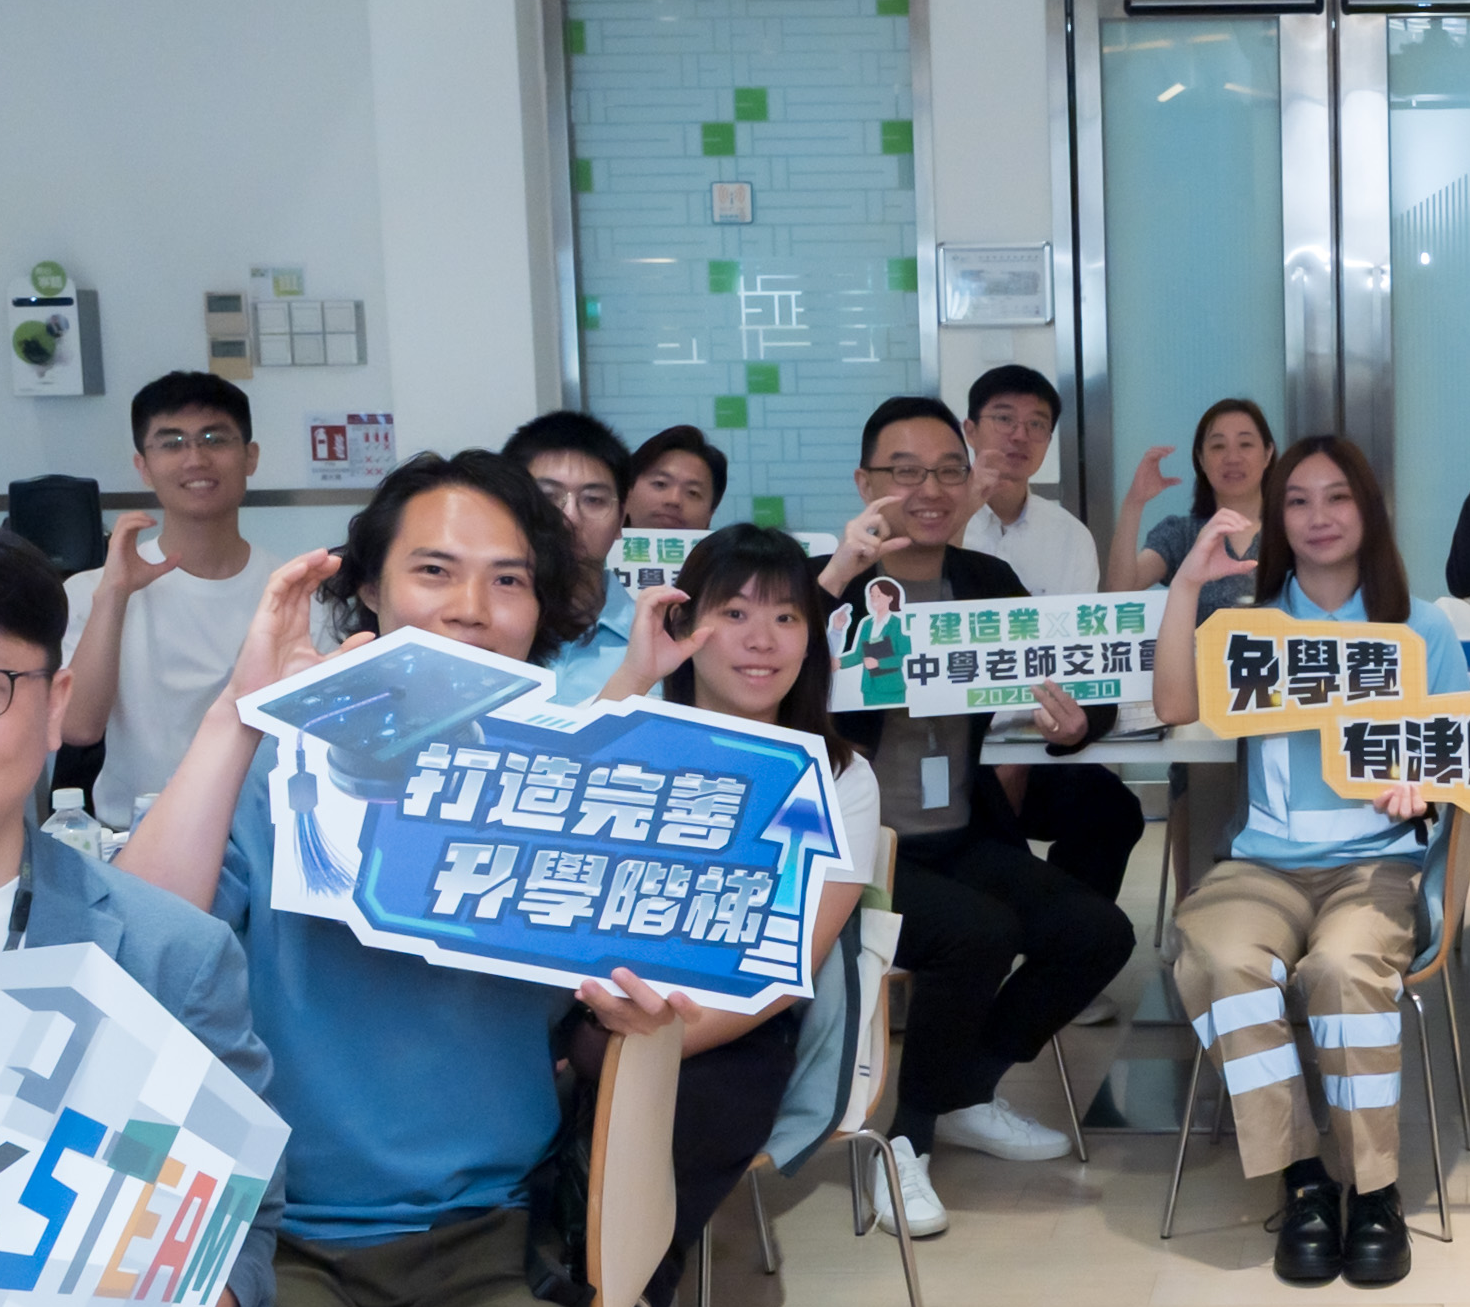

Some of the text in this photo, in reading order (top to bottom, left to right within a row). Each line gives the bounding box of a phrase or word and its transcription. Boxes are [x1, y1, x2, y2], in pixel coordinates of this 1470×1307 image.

[973, 680, 1115, 706] 20265.30
[1227, 632, 1401, 713] 免學費
[404, 742, 751, 850] 打造完善
[431, 841, 776, 944] 升學階梯
